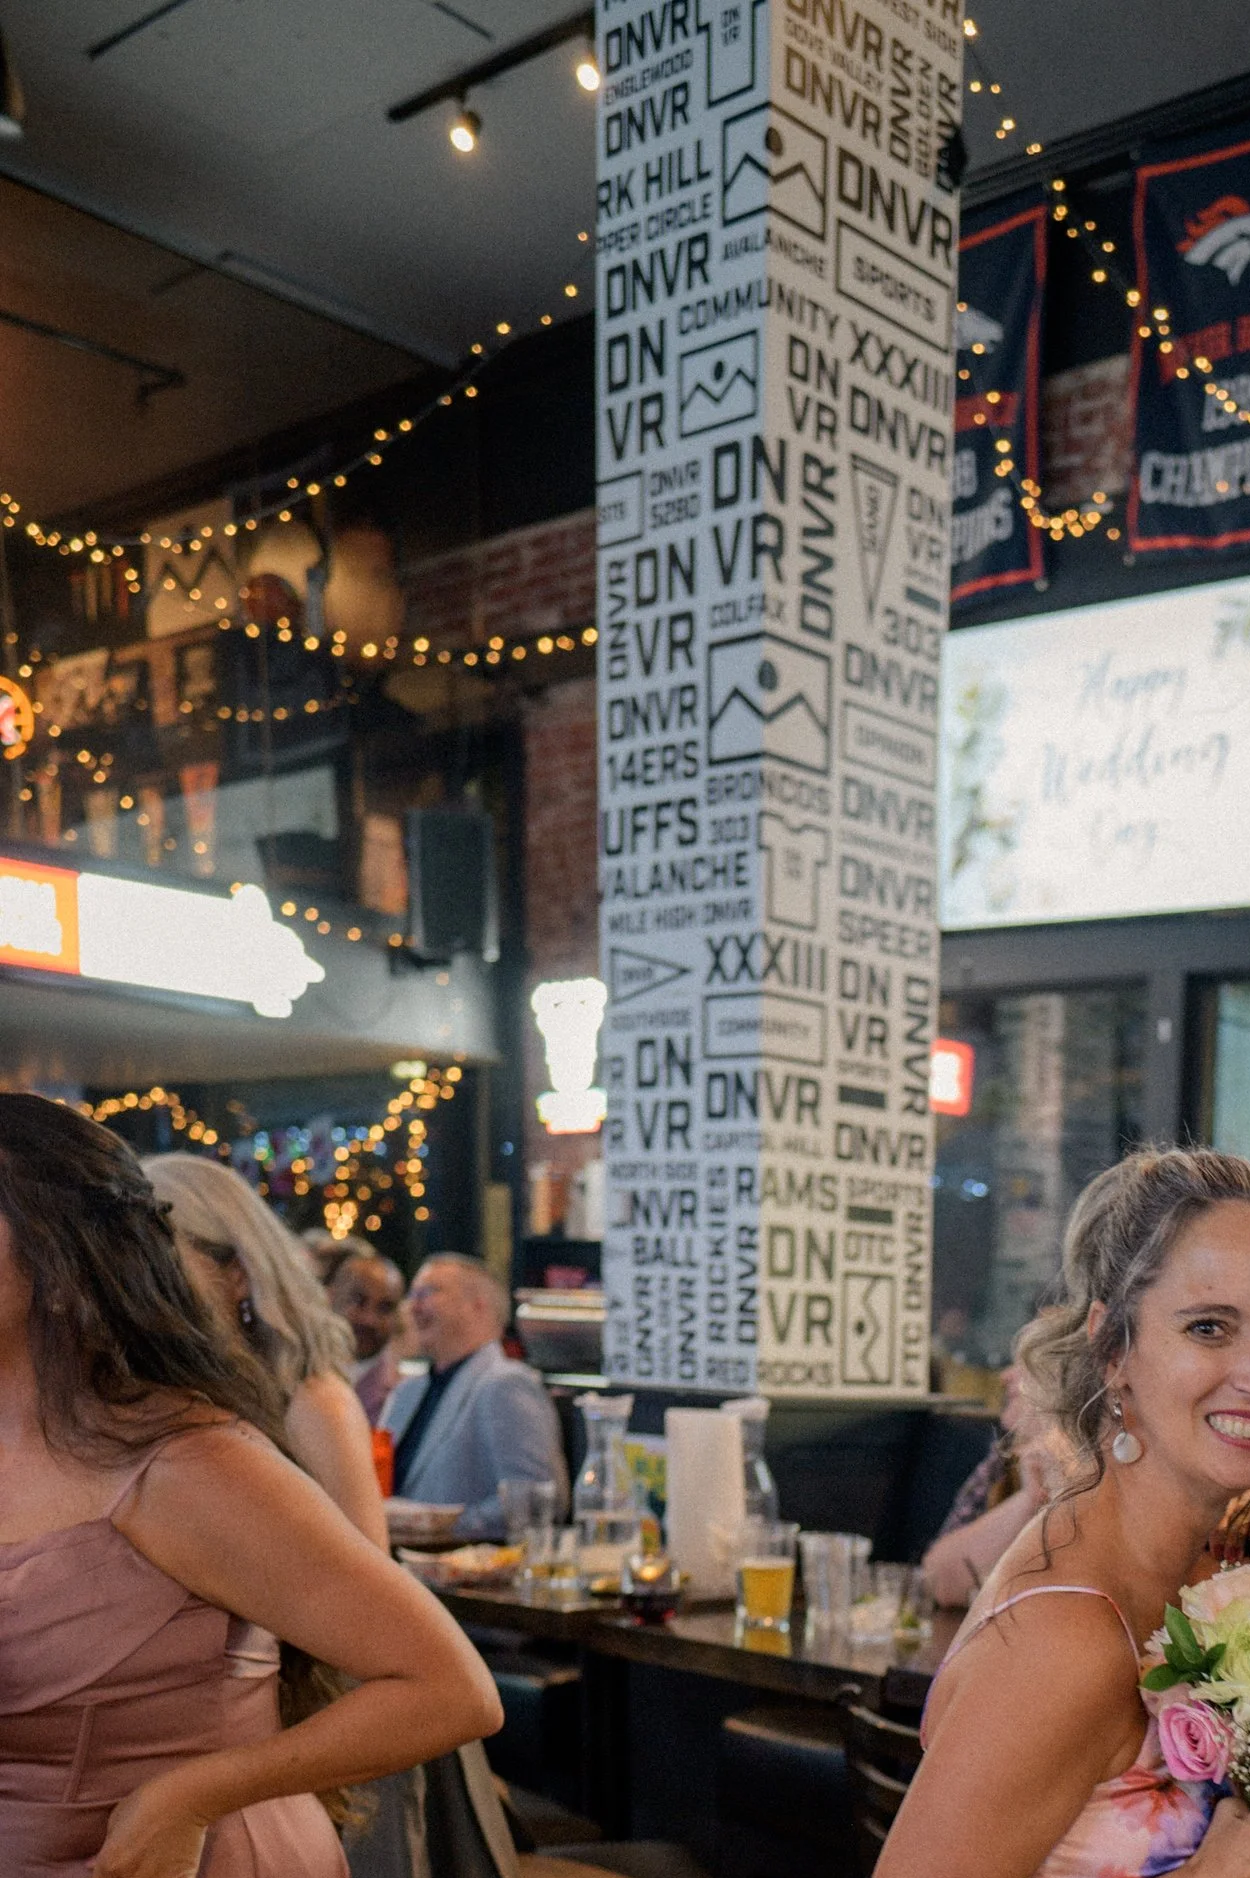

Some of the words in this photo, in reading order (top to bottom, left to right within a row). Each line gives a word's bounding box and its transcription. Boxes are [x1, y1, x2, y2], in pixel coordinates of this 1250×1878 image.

[606, 0, 689, 74] DNVR
[604, 48, 694, 107] ENGLEWOOD
[784, 44, 881, 148] DNVR
[888, 36, 913, 168] DNVR
[606, 80, 689, 159] DNVR
[914, 56, 934, 178] GOLDEN
[644, 138, 712, 202] HILL
[646, 192, 712, 240] CIRCLE
[837, 144, 952, 270] DNVR
[606, 231, 709, 321] DNVR
[678, 276, 841, 340] COMMUNITY
[855, 255, 936, 323] SPORTS
[607, 317, 665, 395] DN
[788, 332, 840, 400] DN
[848, 318, 951, 416] XXXIII
[606, 391, 666, 462] VR
[786, 385, 839, 450] VR
[850, 384, 947, 476] DNVR
[713, 431, 787, 512] DN
[634, 535, 696, 609] DN
[711, 511, 785, 586] VR
[801, 451, 837, 642] DNVR
[608, 558, 628, 682] DNVR
[634, 612, 697, 677] VR
[881, 605, 942, 663] 303
[844, 642, 940, 713] DNVR
[608, 683, 698, 743] DNVR
[606, 740, 698, 794] 14ERS
[706, 769, 831, 818] BRONCOS
[604, 797, 698, 856] UFFS
[840, 775, 937, 846] DNVR
[839, 855, 934, 921] DNVR
[705, 932, 828, 993] XXXIII
[837, 907, 932, 960] SPEER
[837, 958, 890, 1008] DN
[636, 1035, 693, 1089] DN
[837, 1008, 890, 1059] VR
[904, 974, 931, 1117] DNVR
[635, 1100, 693, 1152] VR
[706, 1067, 822, 1127] DNVR
[835, 1122, 926, 1174] DNVR
[736, 1165, 839, 1213] RAMS
[706, 1164, 728, 1344] ROCKIES
[737, 1223, 758, 1345] DNVR
[768, 1225, 836, 1282] DN
[903, 1210, 923, 1312] DNVR
[634, 1275, 653, 1377] DNVR
[677, 1276, 697, 1380] DNVR
[767, 1288, 834, 1346] VR
